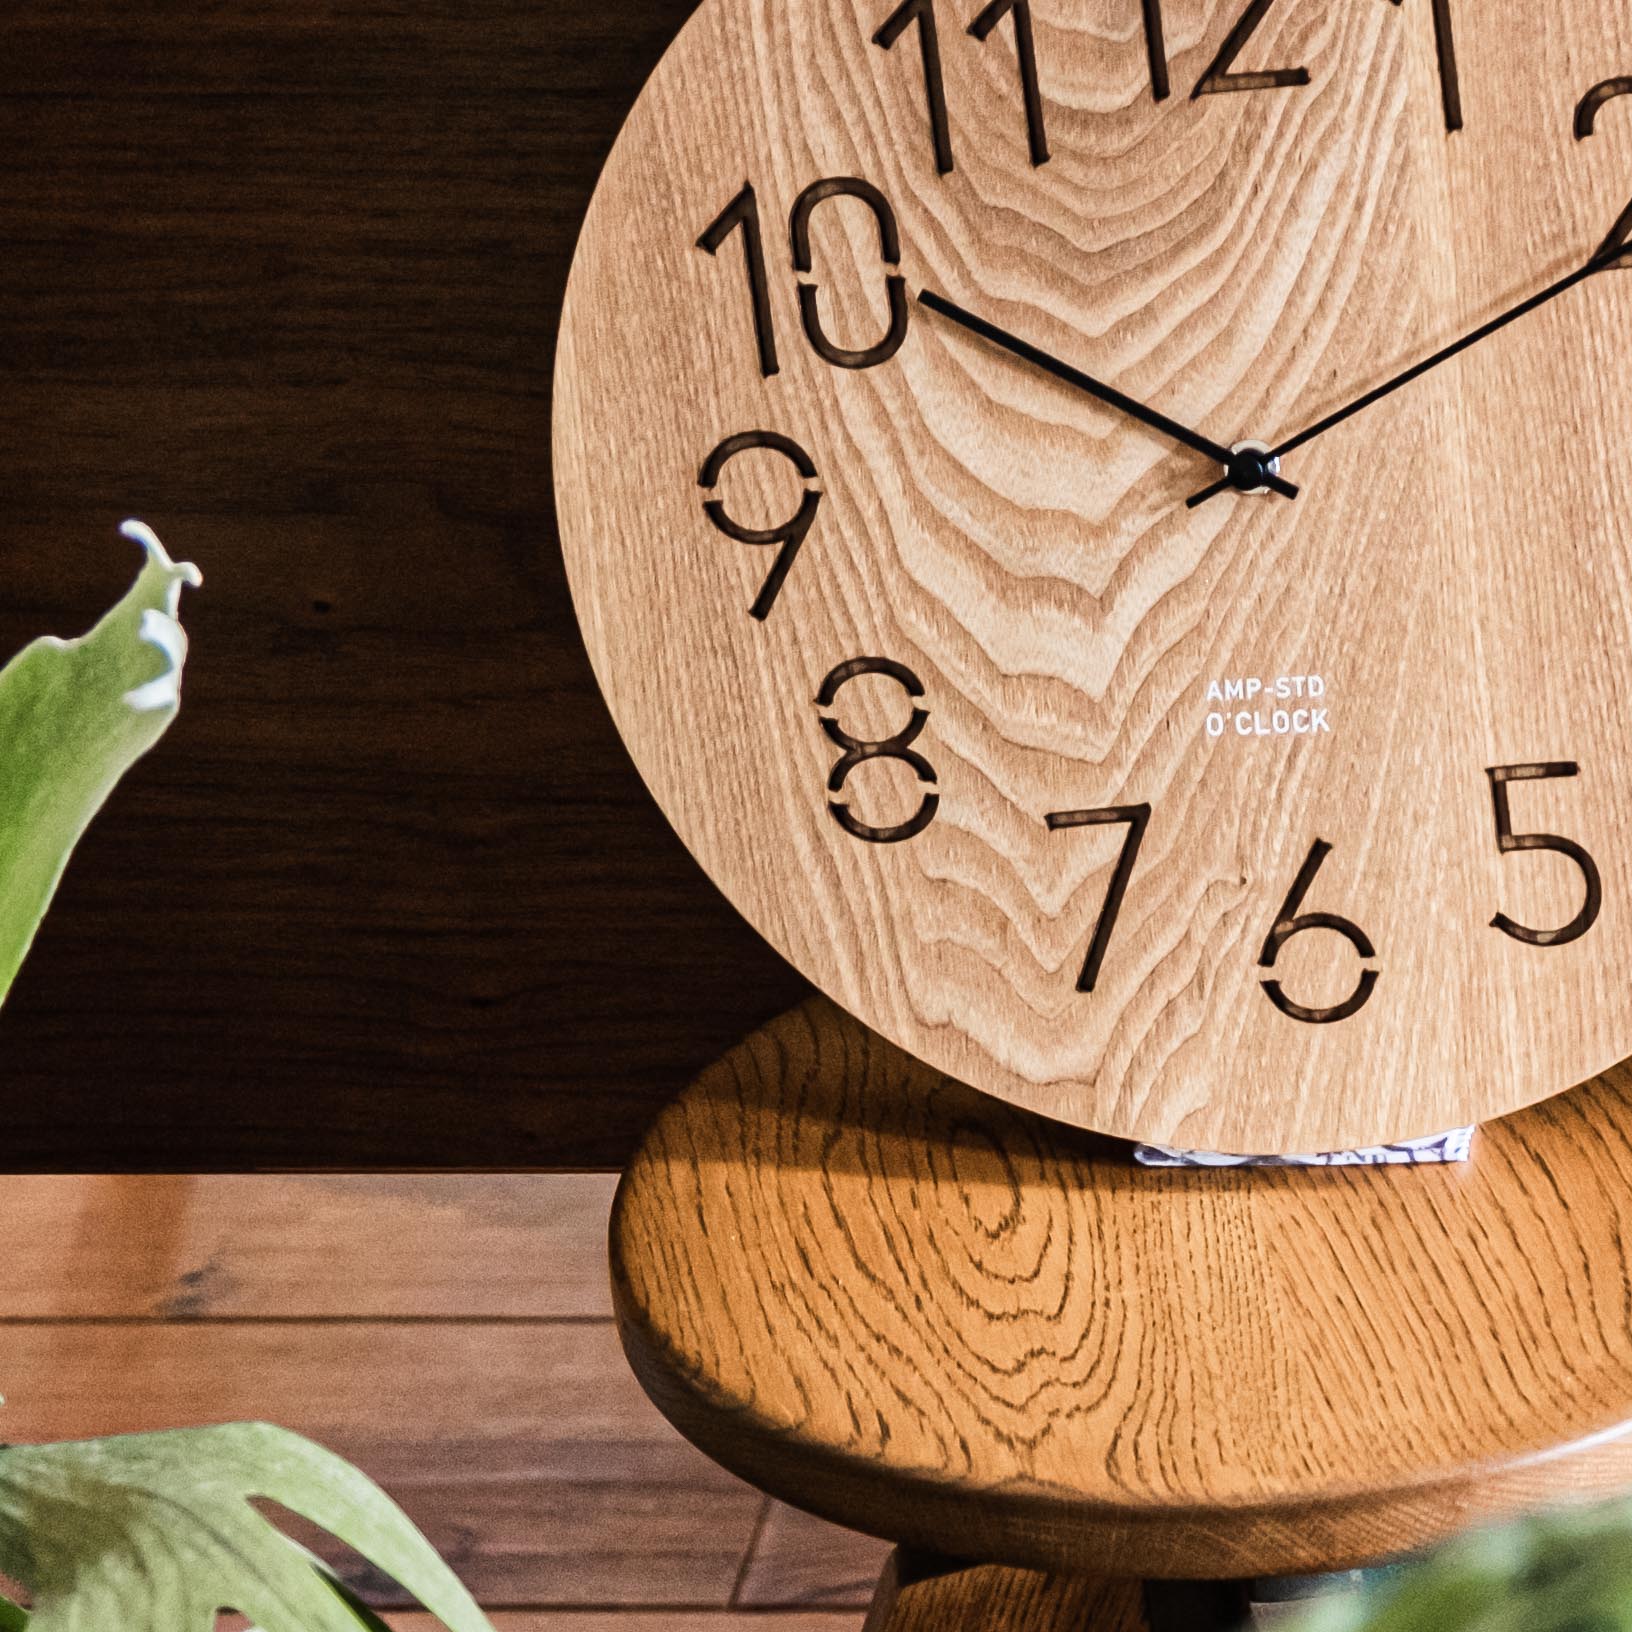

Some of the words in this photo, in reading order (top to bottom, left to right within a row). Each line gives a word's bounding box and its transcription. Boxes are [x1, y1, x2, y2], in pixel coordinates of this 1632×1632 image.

[872, 0, 1051, 176] 11
[696, 177, 906, 376] 10
[697, 429, 821, 620] 9
[816, 655, 939, 845] 8
[1205, 708, 1330, 737] O'CLOCK
[1206, 674, 1325, 701] AMP-STD
[1044, 802, 1150, 995] 7
[1259, 838, 1380, 1024] 6
[1486, 761, 1602, 947] 5
